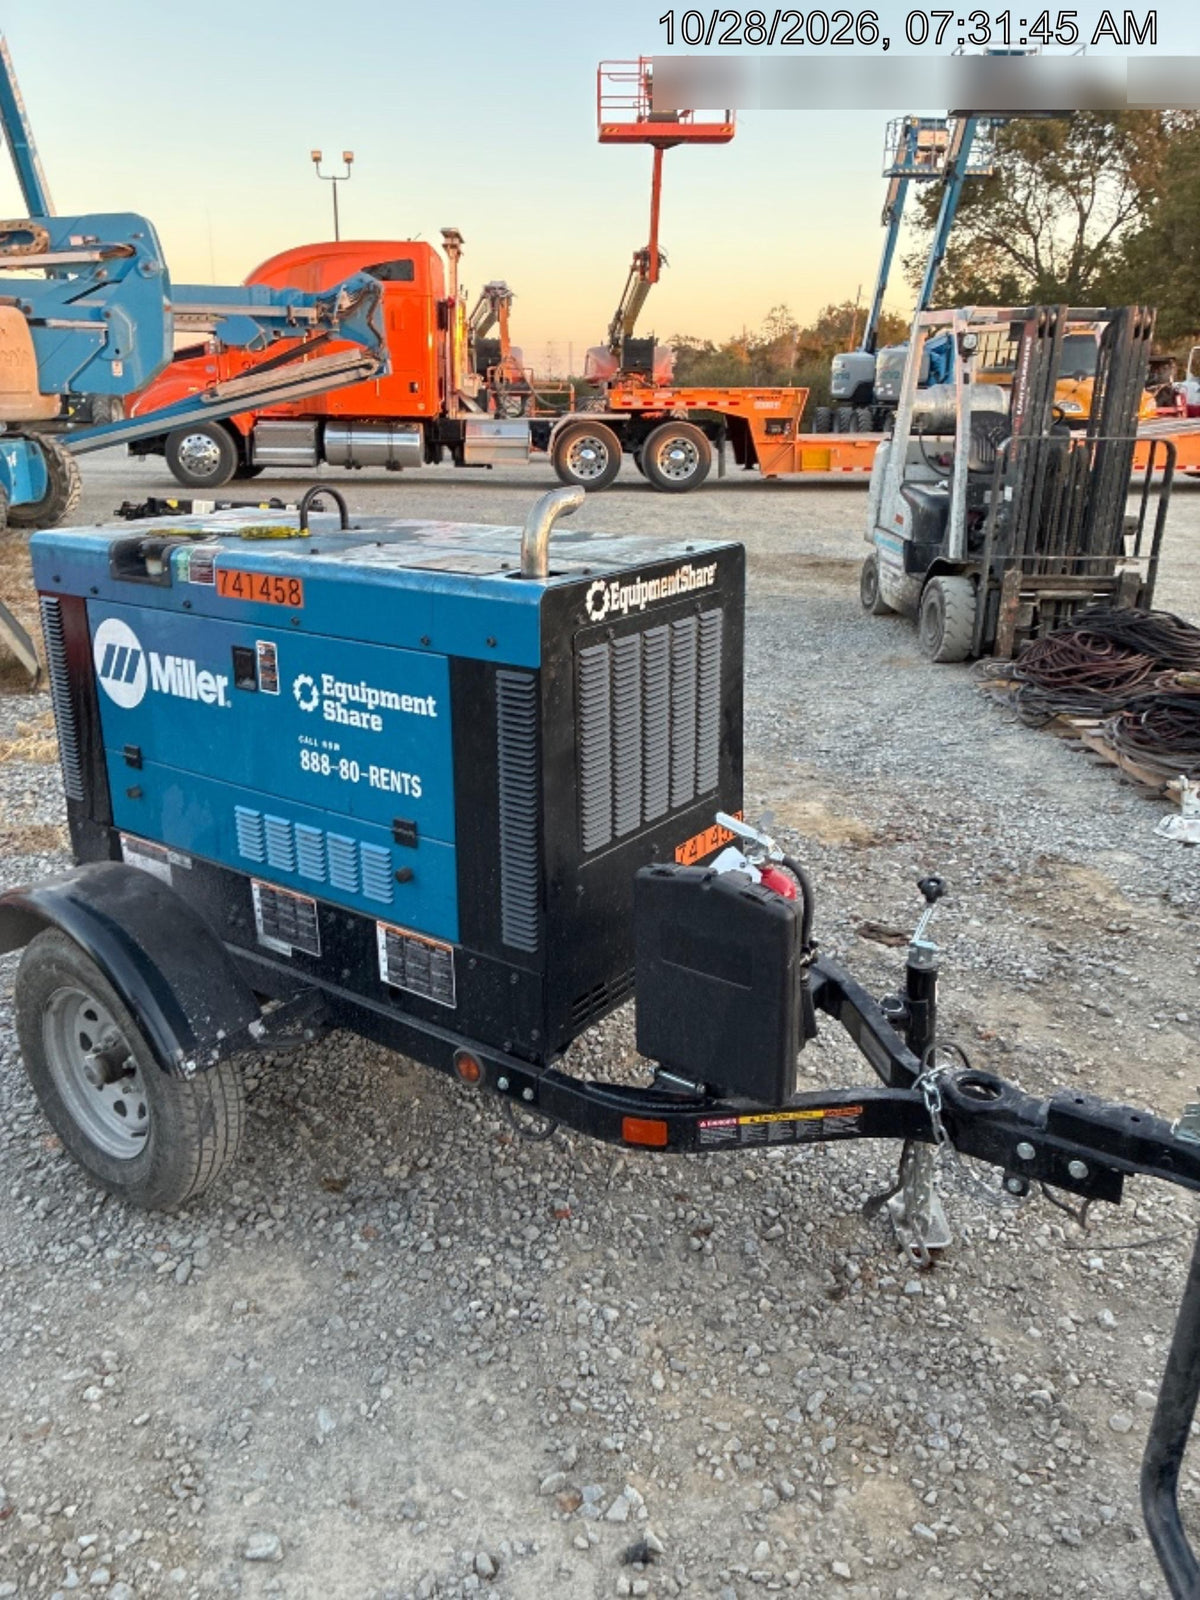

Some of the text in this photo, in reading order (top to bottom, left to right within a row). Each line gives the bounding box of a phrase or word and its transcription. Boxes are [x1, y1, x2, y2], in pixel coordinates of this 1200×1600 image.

[218, 570, 301, 606] 741458
[610, 563, 716, 614] EquipmentShare
[149, 651, 229, 707] Miller
[321, 673, 438, 717] Equipment
[322, 699, 383, 732] Share
[300, 749, 422, 798] 888-80-RENTS
